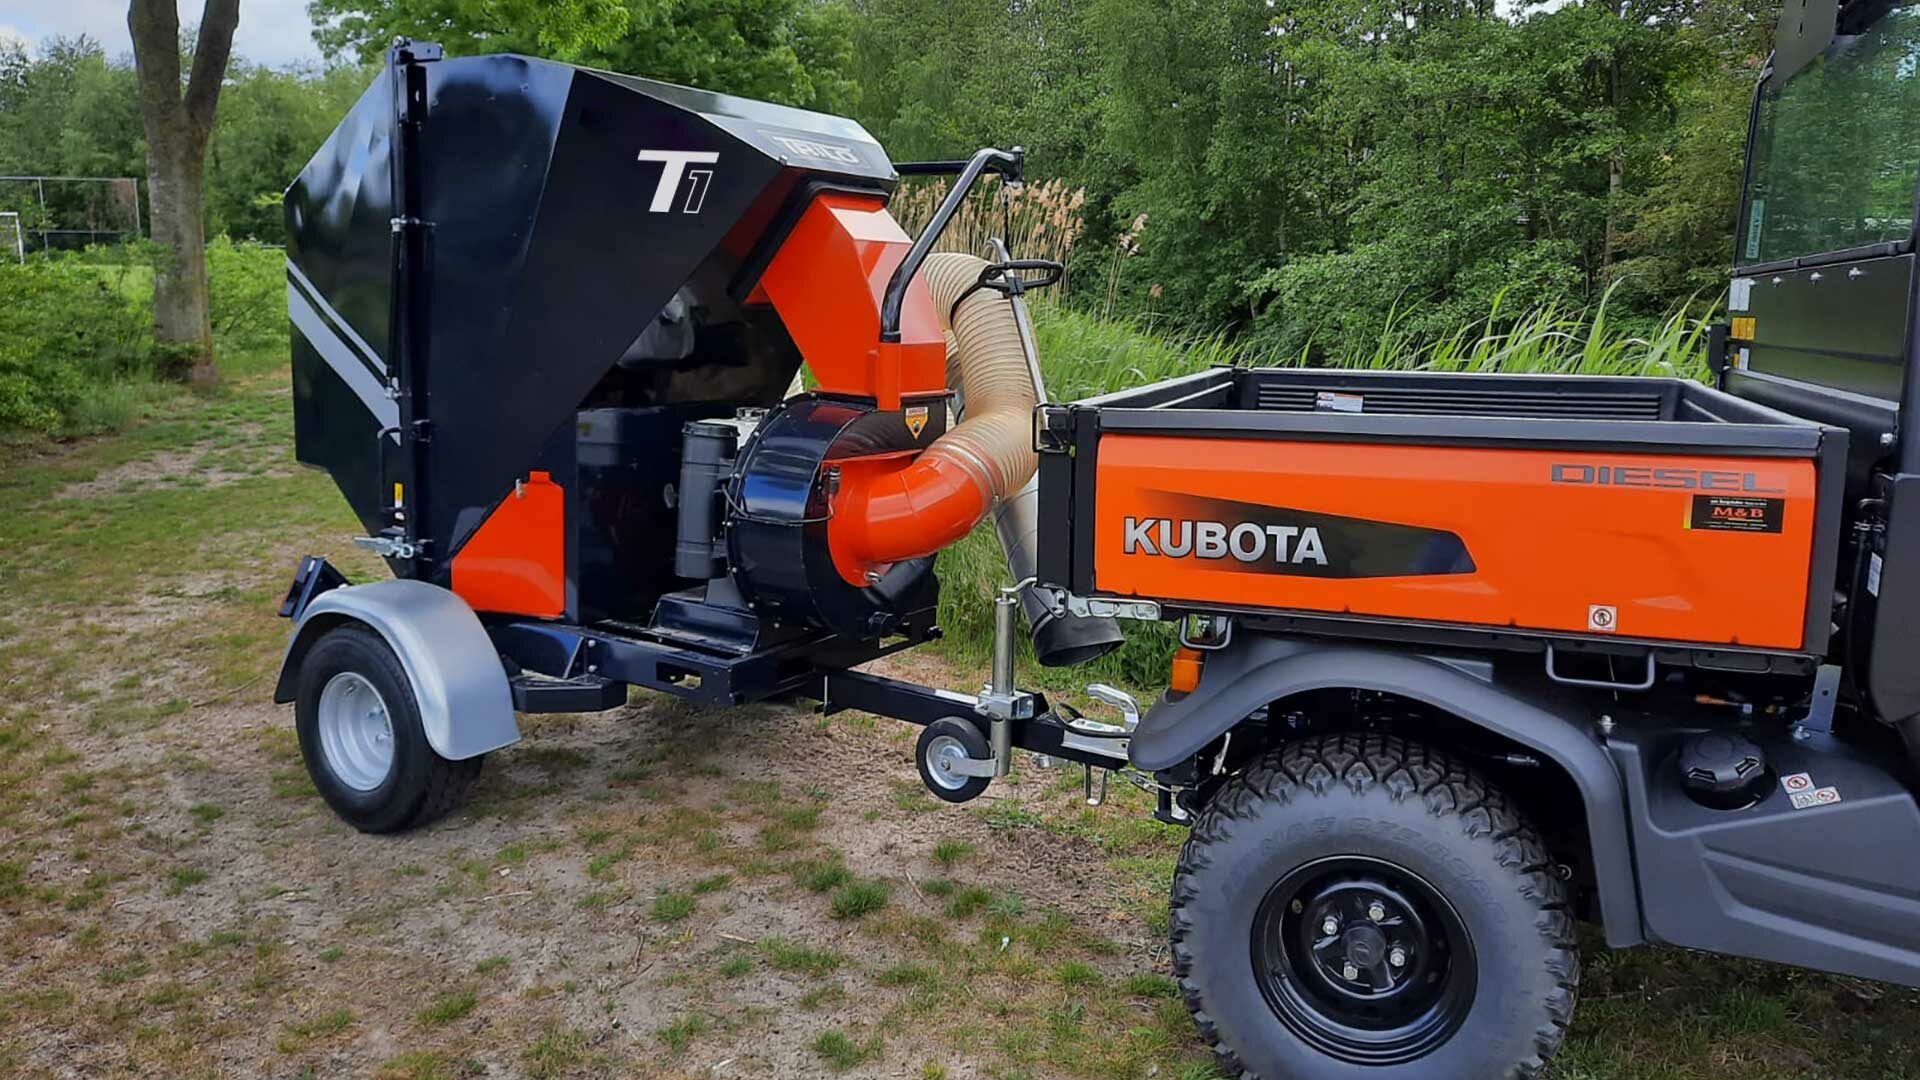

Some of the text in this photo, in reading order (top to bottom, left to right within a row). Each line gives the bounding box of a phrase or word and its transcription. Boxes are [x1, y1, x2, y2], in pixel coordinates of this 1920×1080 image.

[637, 149, 720, 214] T1
[1551, 464, 1786, 493] DIESEL
[1124, 517, 1329, 566] KUBOTA
